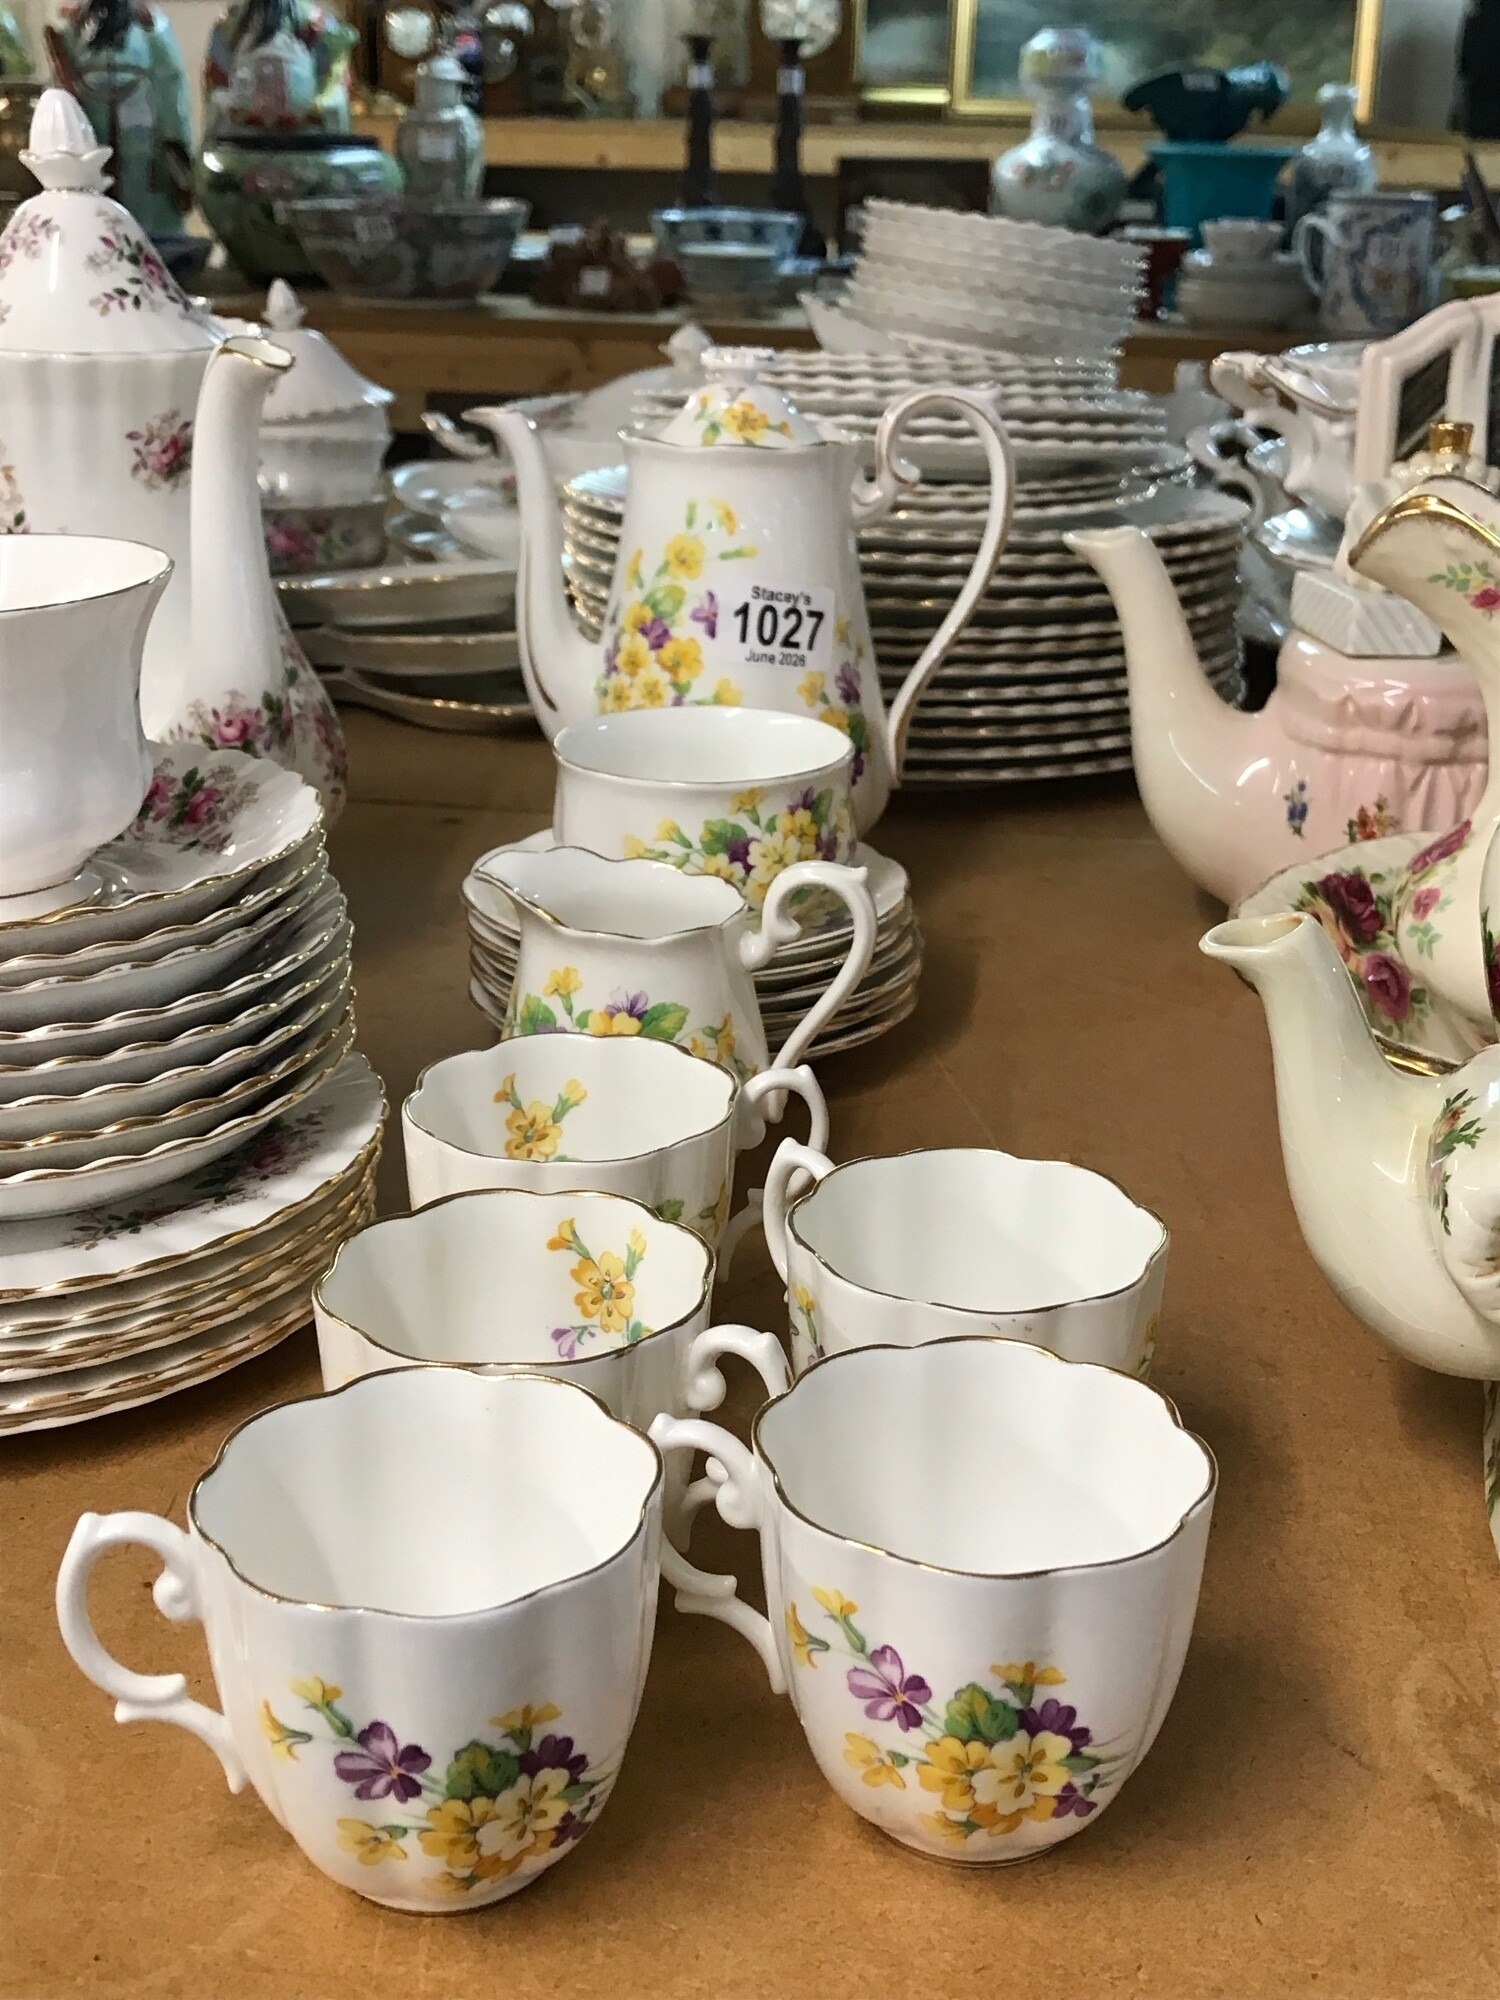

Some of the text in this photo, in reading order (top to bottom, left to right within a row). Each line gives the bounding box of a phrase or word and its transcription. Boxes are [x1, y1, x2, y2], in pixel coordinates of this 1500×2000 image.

[751, 585, 812, 607] Stacey's
[733, 602, 825, 651] 1027
[744, 649, 776, 665] June
